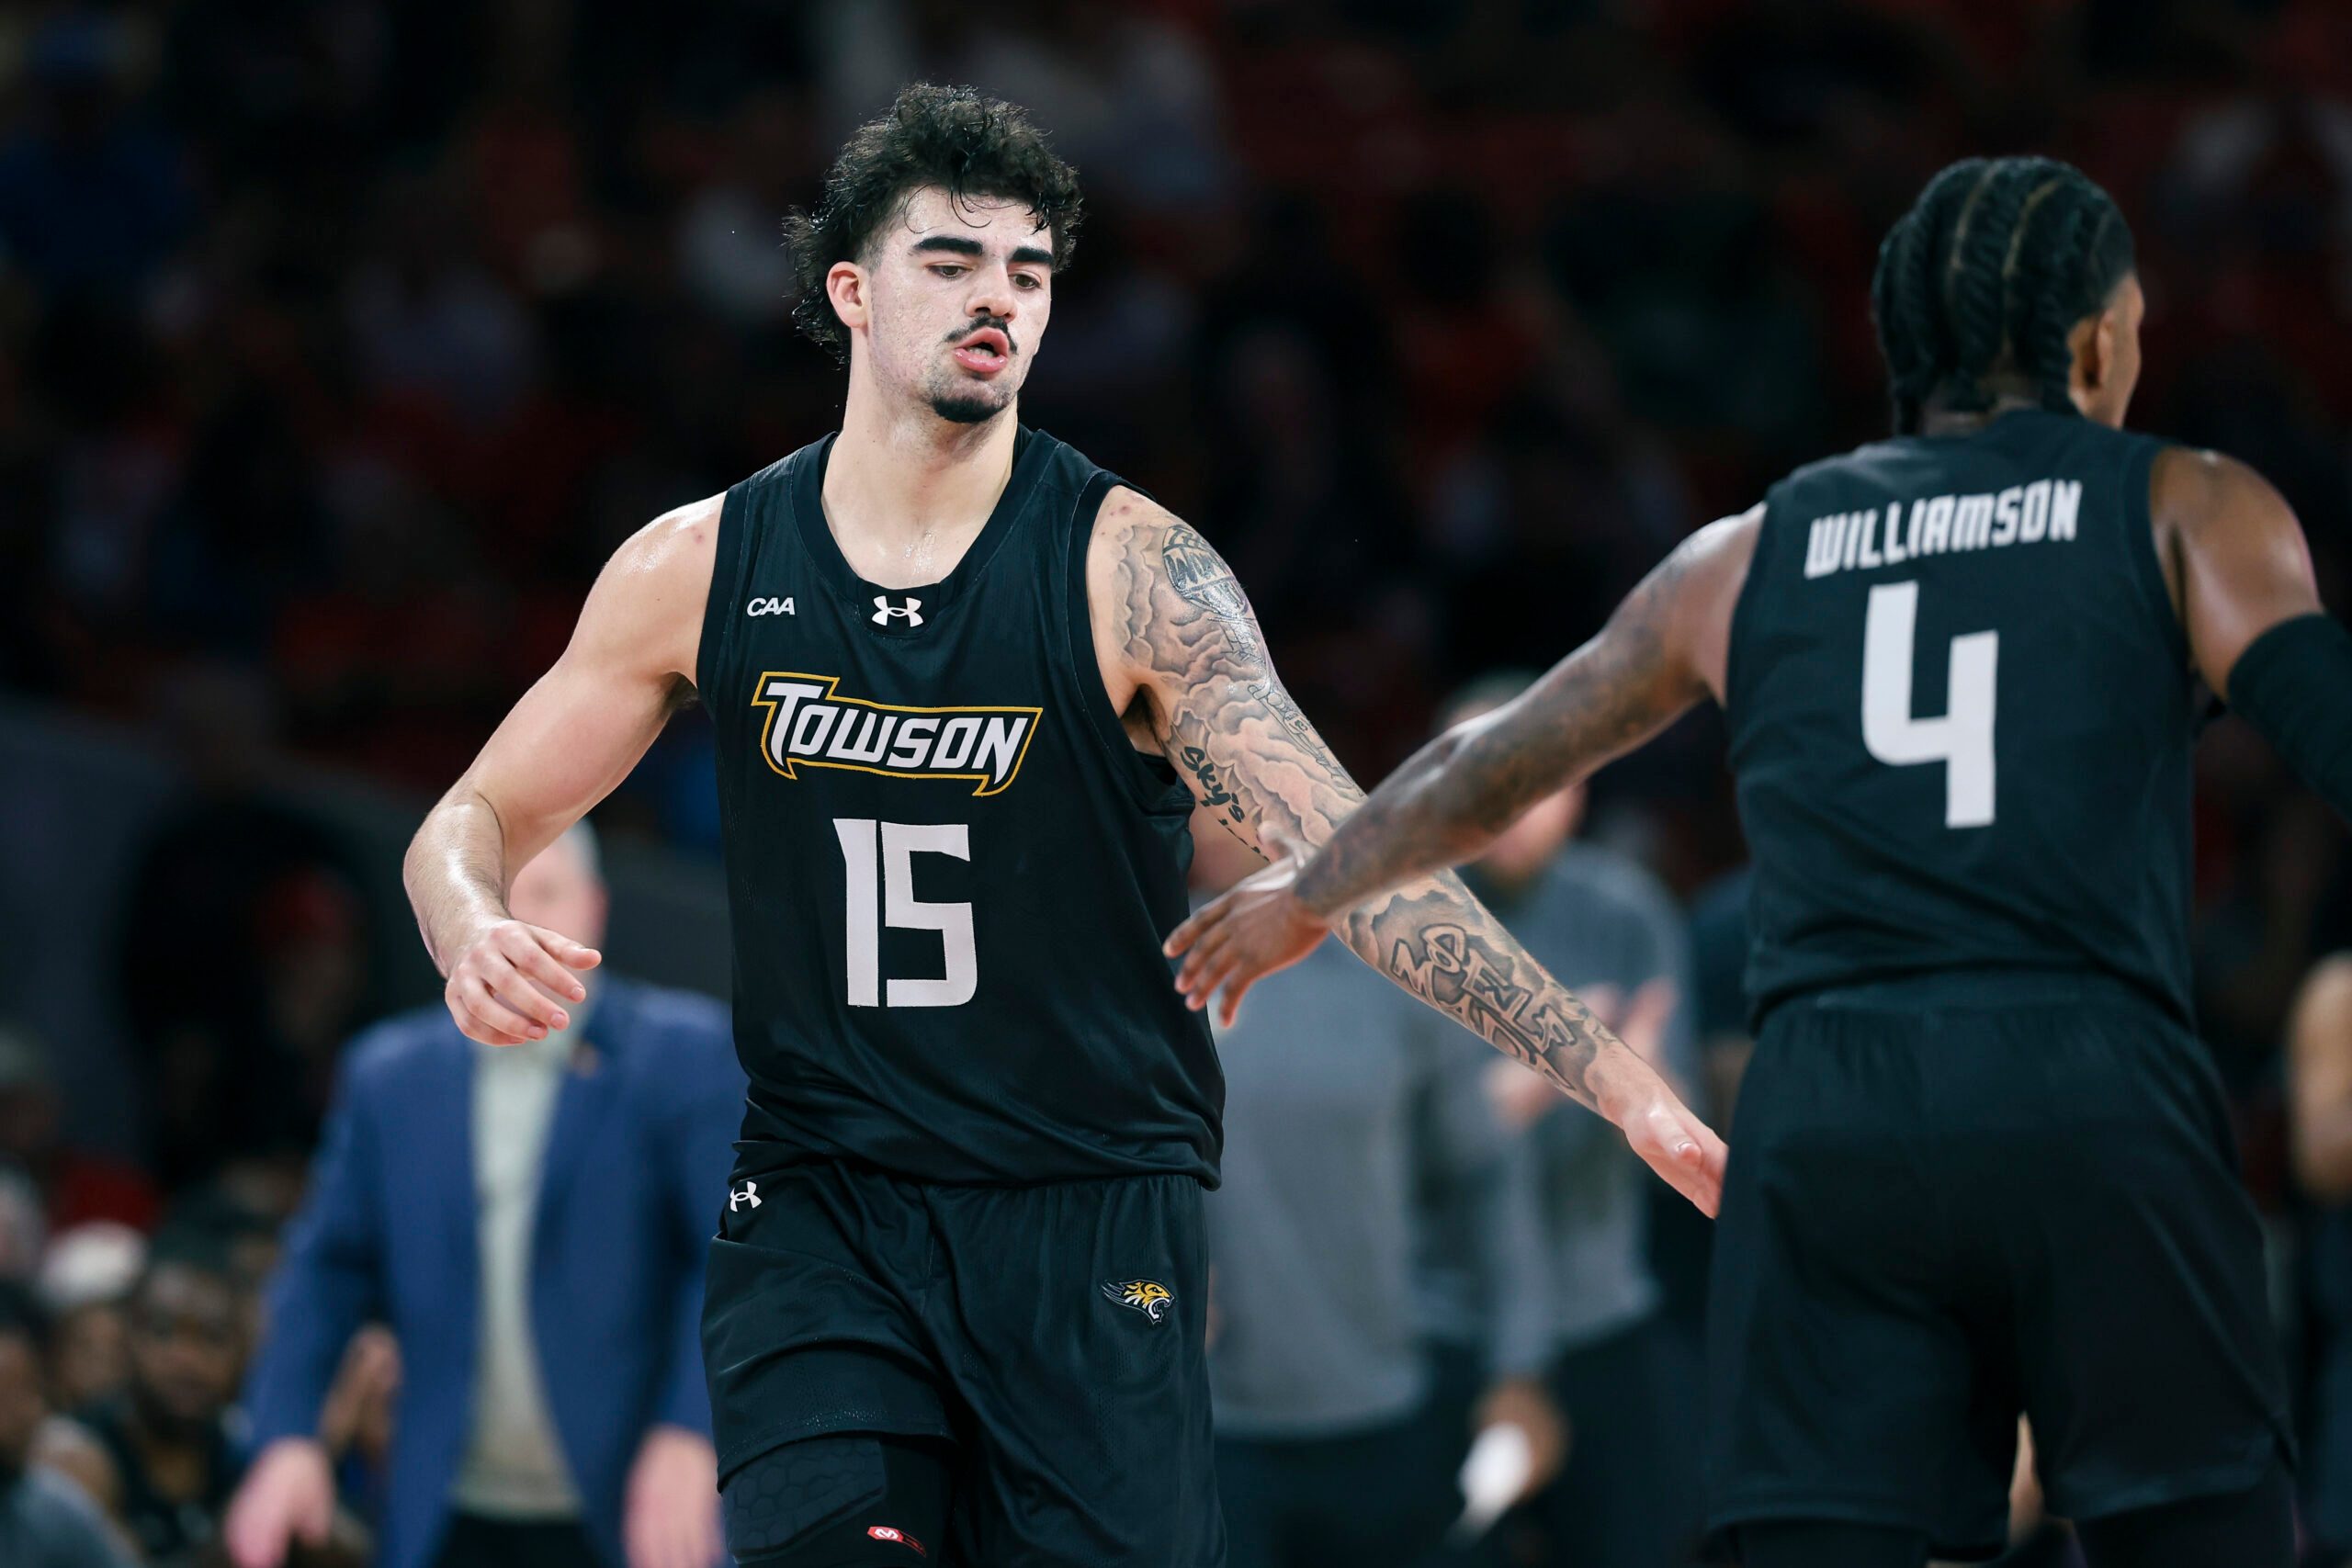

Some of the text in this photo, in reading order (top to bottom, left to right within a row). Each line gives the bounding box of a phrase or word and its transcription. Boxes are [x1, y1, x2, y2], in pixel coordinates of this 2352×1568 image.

[1804, 479, 2083, 580] WILLIAMSON
[746, 596, 796, 617] CAA
[1860, 580, 1999, 829] 4
[832, 818, 978, 1008] 15
